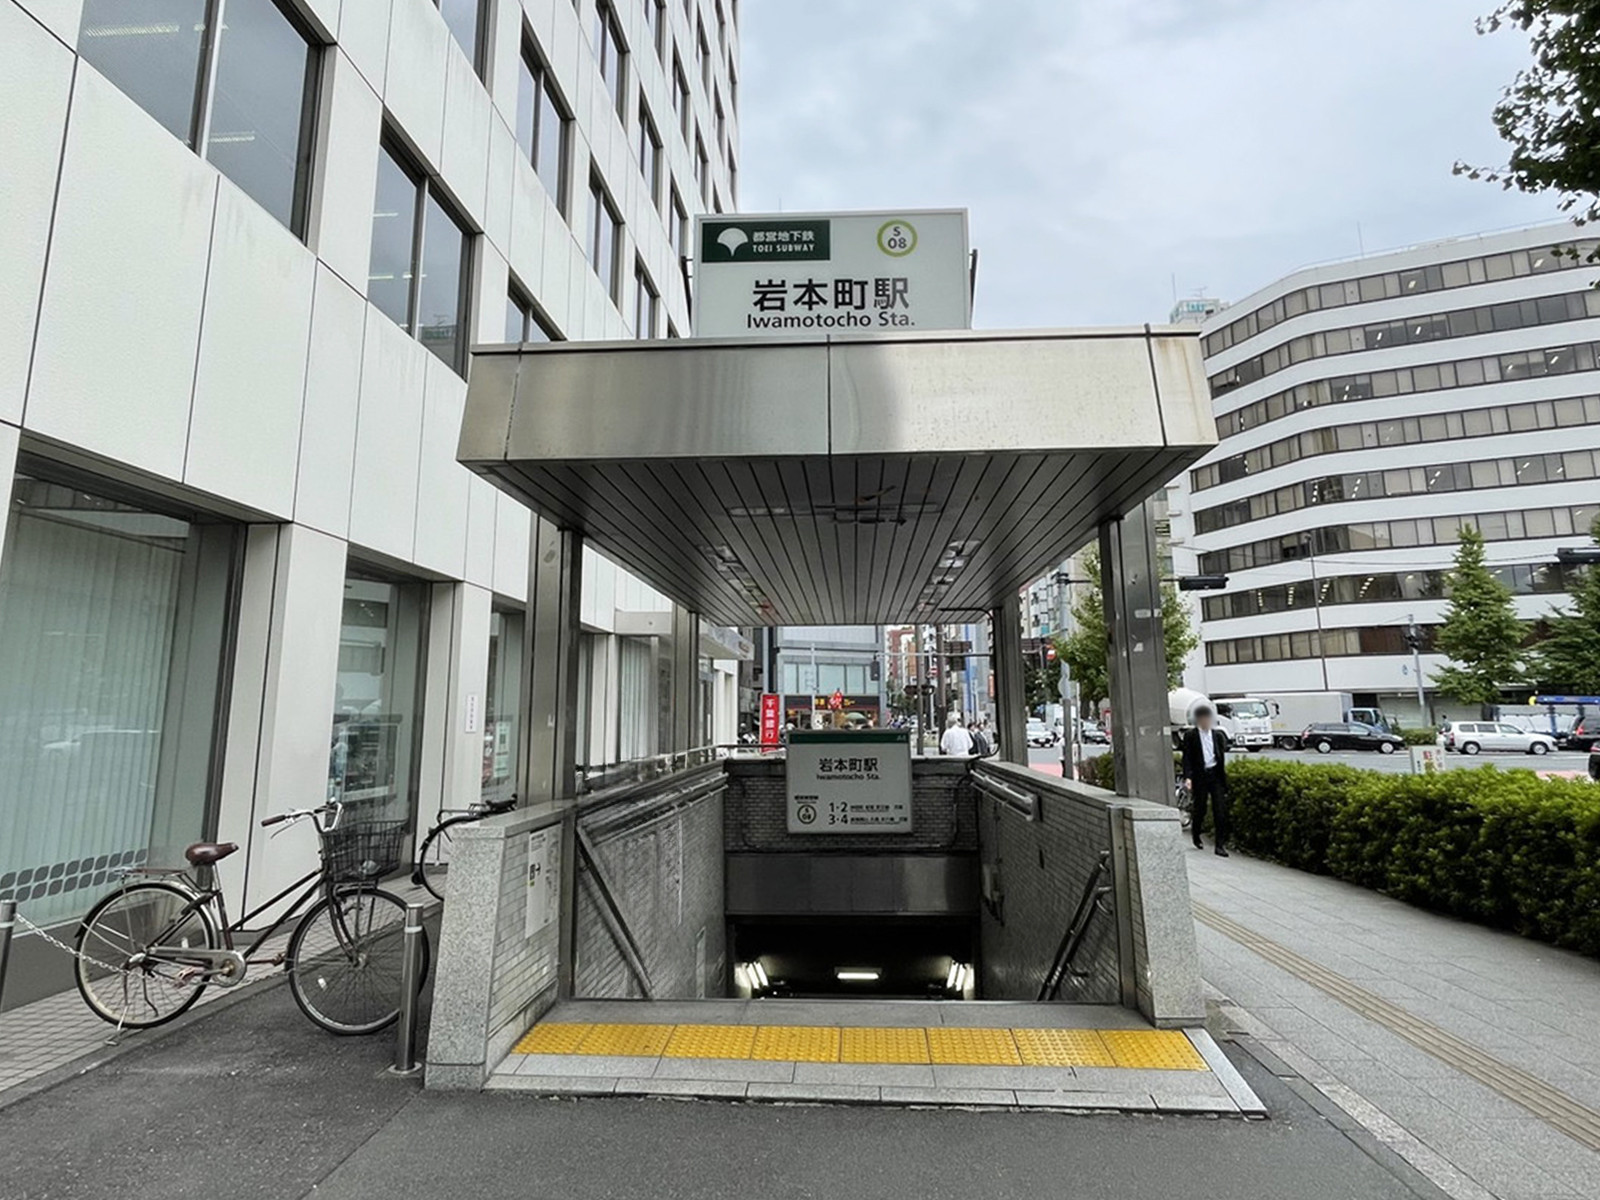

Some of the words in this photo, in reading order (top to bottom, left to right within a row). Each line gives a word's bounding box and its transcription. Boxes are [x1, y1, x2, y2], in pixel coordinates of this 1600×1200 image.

[753, 230, 815, 242] 都営地下鉄
[893, 226, 901, 237] S
[752, 244, 773, 252] TOEI
[776, 243, 815, 252] SUBWAY
[888, 237, 907, 249] 08
[752, 277, 909, 312] 岩本町駅
[747, 312, 872, 329] Iwamotocho
[878, 311, 915, 327] Sta.
[819, 757, 878, 772] 岩本町駅
